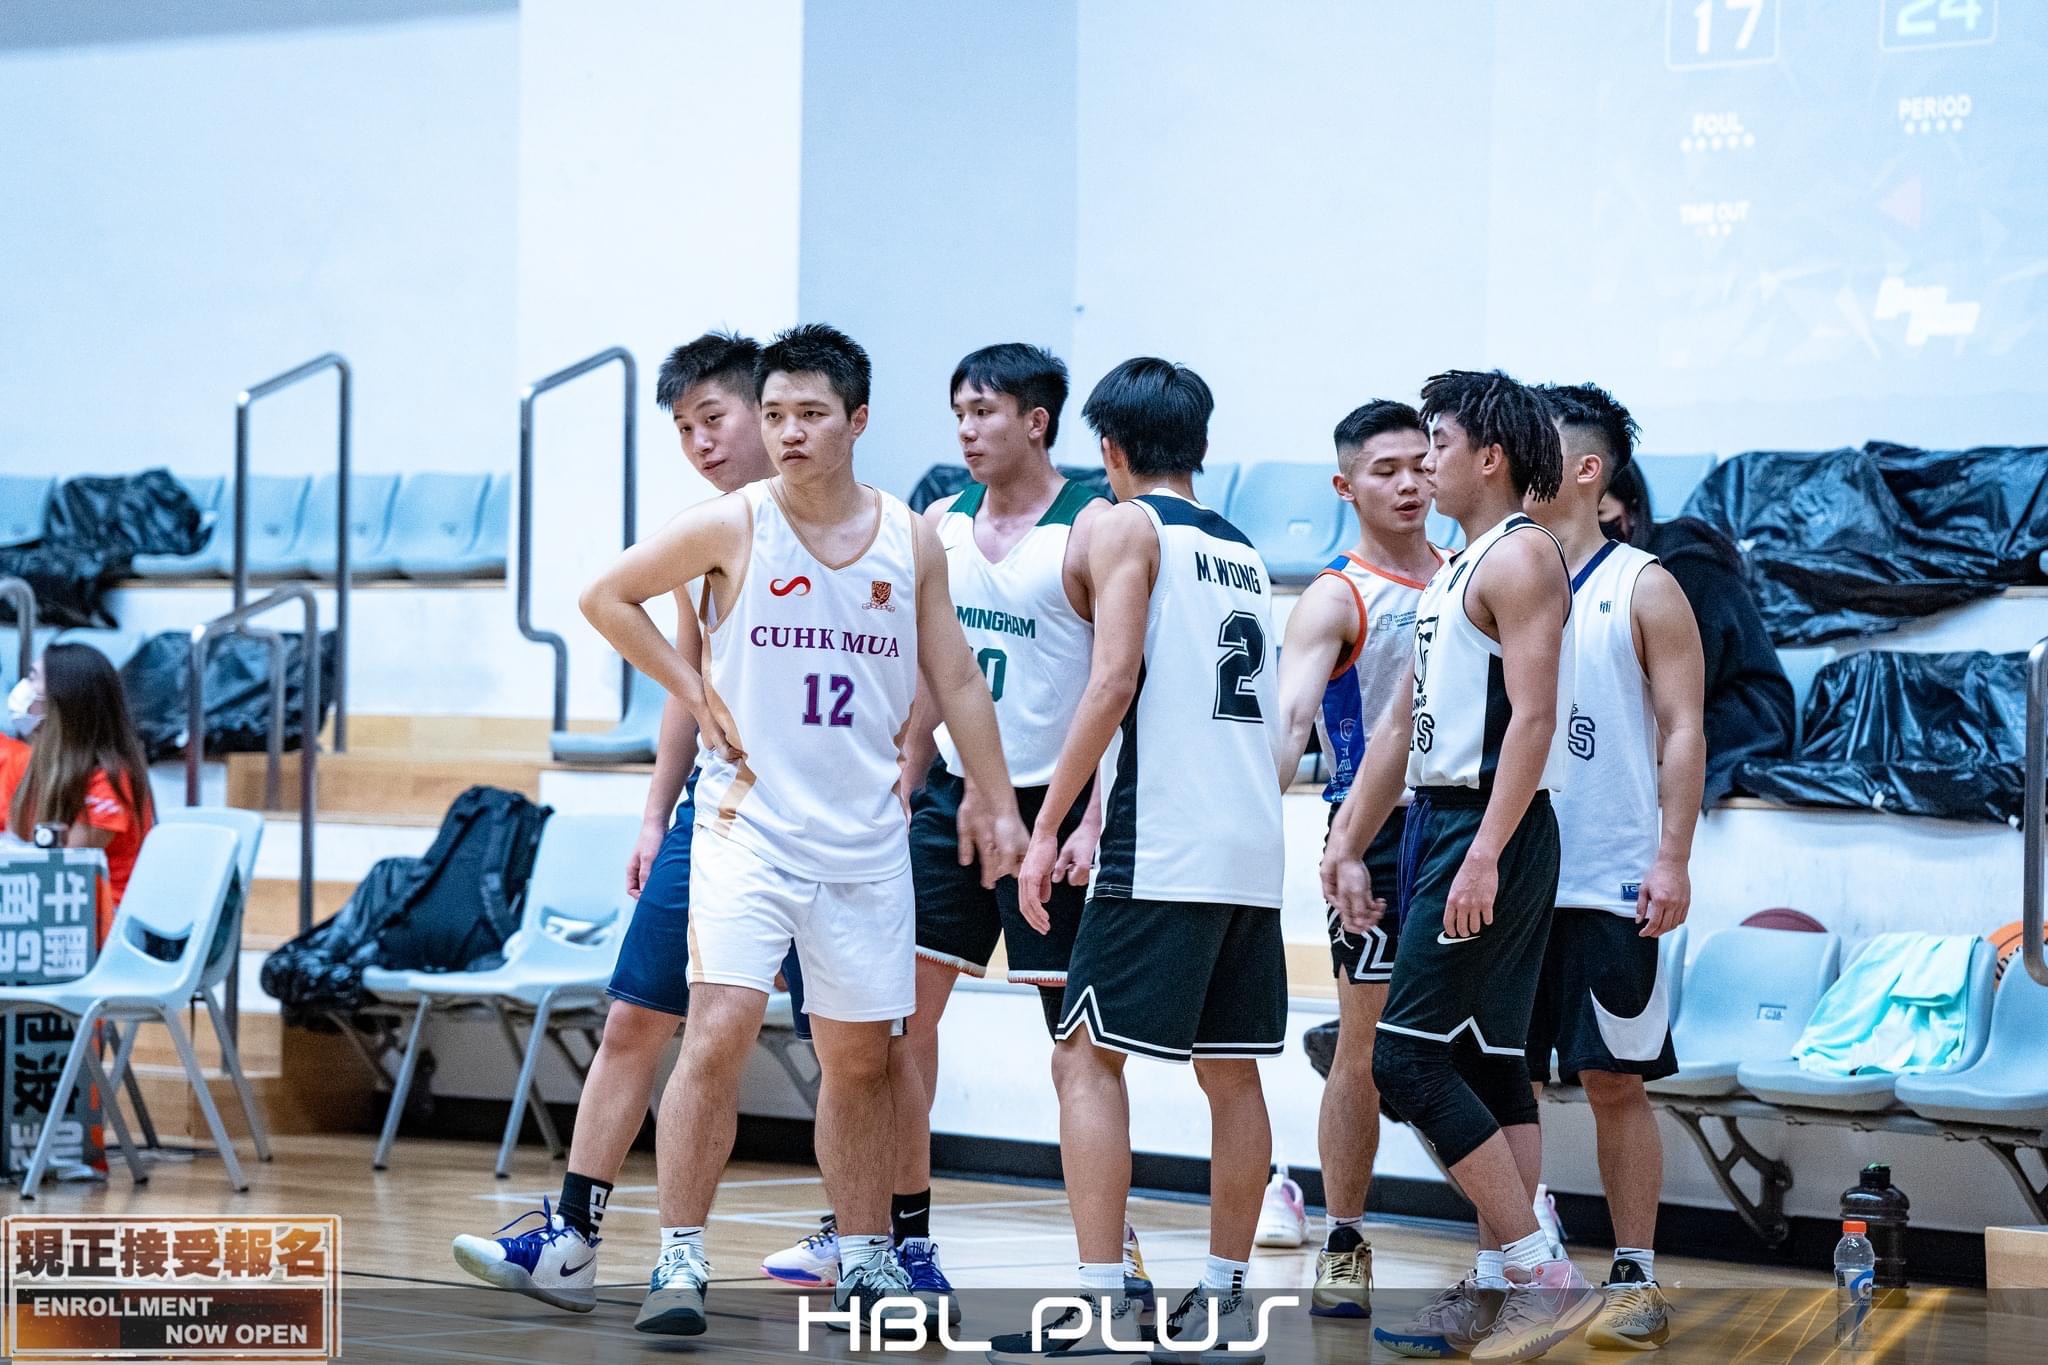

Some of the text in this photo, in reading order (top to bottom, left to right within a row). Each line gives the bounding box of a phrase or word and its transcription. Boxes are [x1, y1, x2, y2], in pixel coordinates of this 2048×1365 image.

[1694, 0, 1764, 54] 17
[1692, 112, 1744, 136] FOUL
[1898, 95, 1972, 120] PERIOD
[1716, 200, 1750, 222] OUT
[1194, 552, 1262, 595] M.WONG
[750, 625, 900, 658] CUHK MUA
[956, 606, 1036, 639] MINGHAM
[969, 646, 1008, 703] 0
[1212, 610, 1266, 724] 2
[801, 672, 855, 728] 12
